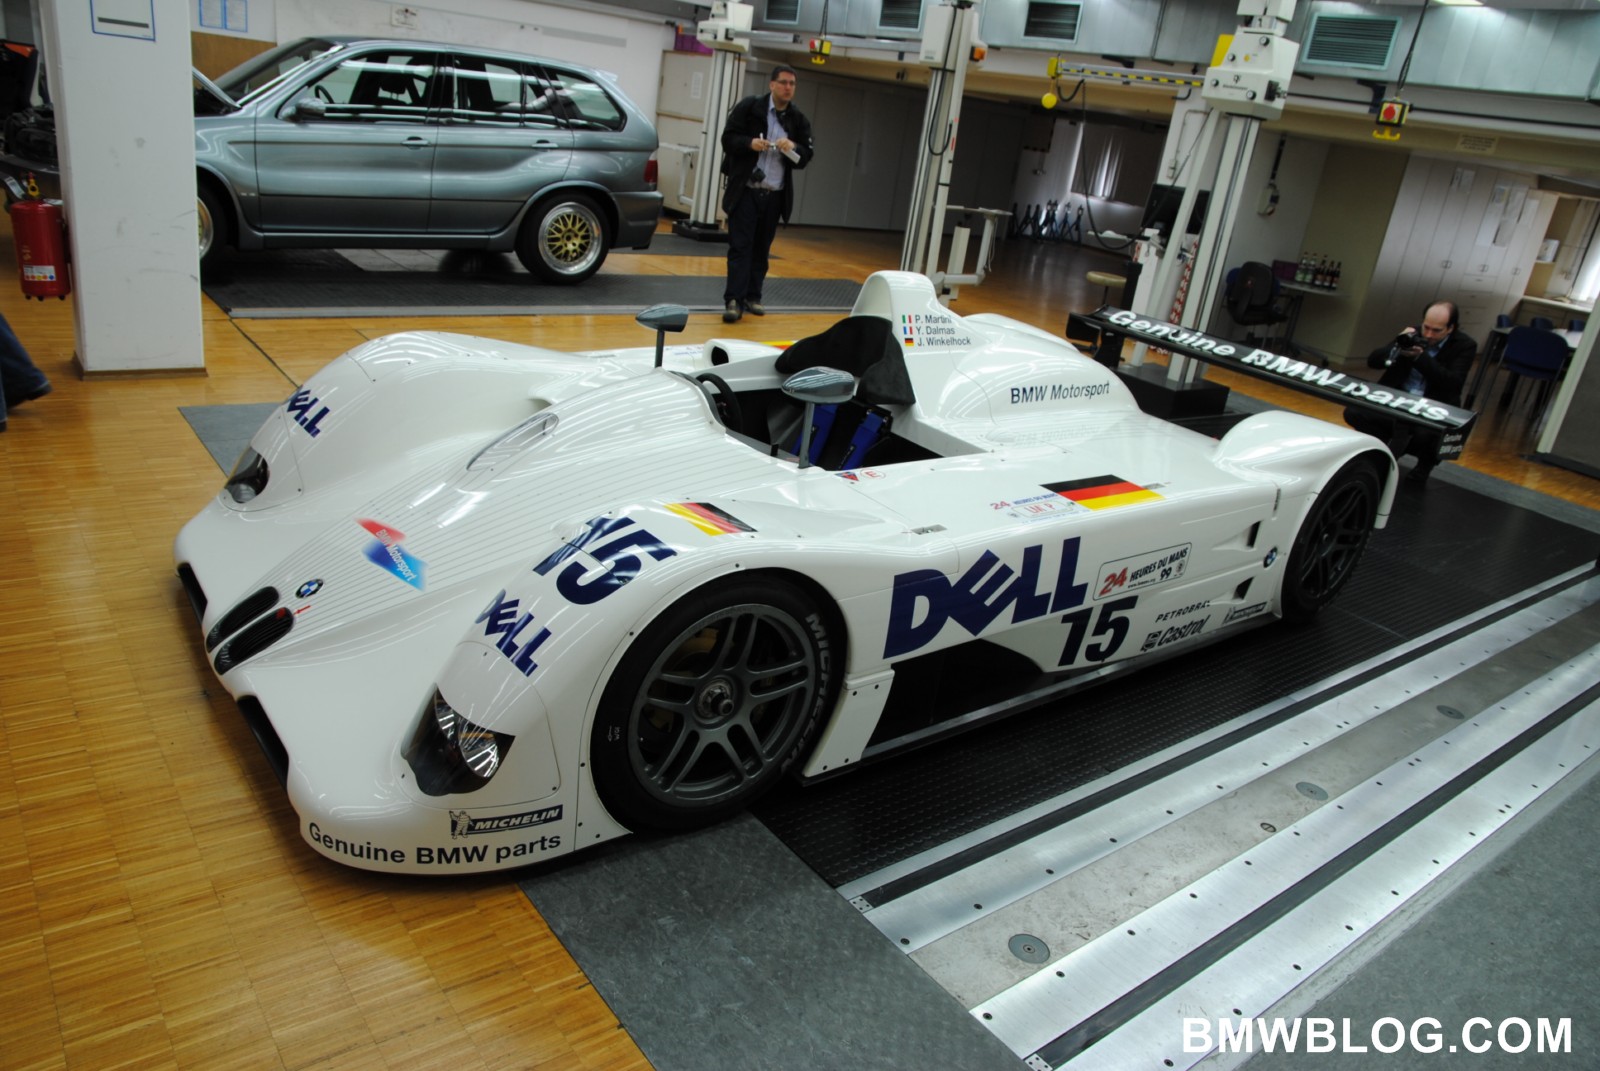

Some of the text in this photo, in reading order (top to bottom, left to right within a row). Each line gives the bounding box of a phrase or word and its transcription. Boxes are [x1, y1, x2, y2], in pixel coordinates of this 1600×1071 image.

[925, 315, 952, 324] Martini
[926, 325, 955, 335] Dalmas
[926, 336, 972, 346] Winkelhock
[1108, 310, 1450, 422] Genuine BMW parts
[1010, 380, 1111, 404] BMW Motorsport
[386, 543, 418, 581] Motorsport
[532, 515, 677, 605] 15
[1098, 547, 1189, 597] 24 HEURES DU MANS
[1160, 566, 1172, 581] 99
[883, 536, 1089, 660] DELL
[1057, 595, 1139, 667] 15
[1157, 614, 1212, 647] Castrol
[473, 807, 561, 831] MICHELIN
[308, 821, 562, 865] Genuine BMW parts
